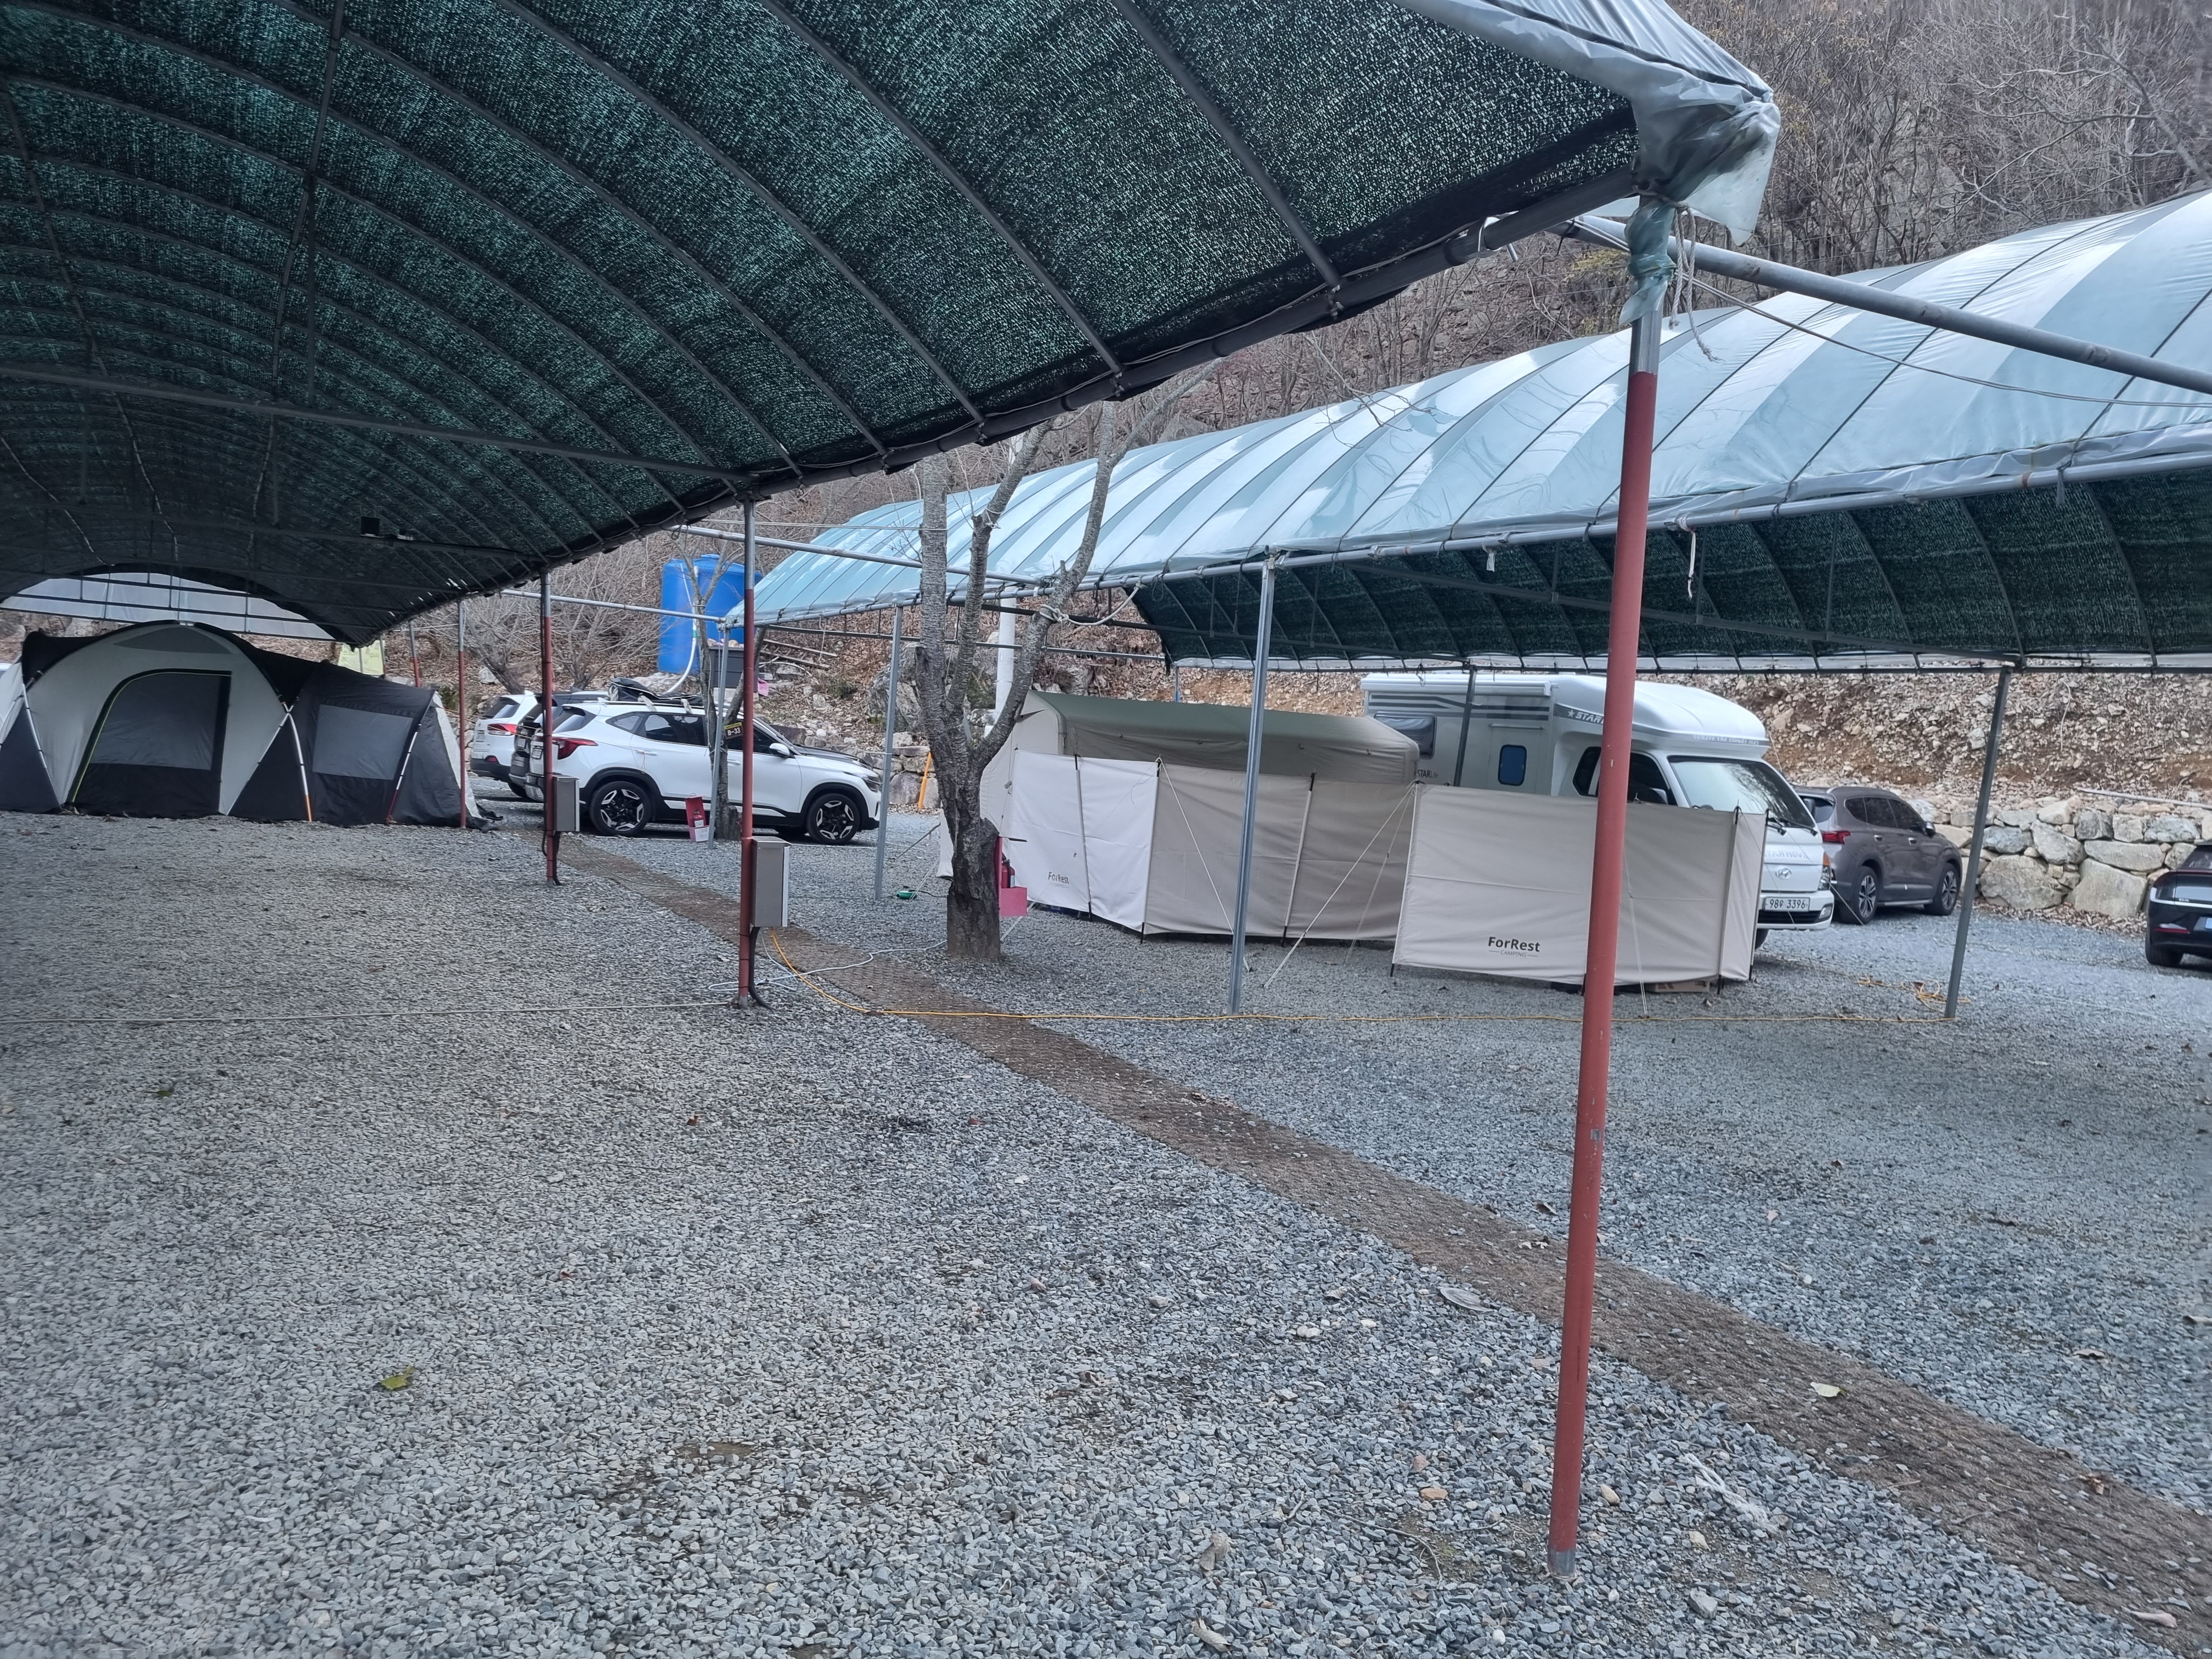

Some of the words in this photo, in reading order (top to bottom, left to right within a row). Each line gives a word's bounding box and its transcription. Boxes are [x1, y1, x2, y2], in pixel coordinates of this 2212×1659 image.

[727, 727, 741, 736] B-33
[1787, 899, 1805, 909] 3396
[1488, 936, 1541, 952] ForRest
